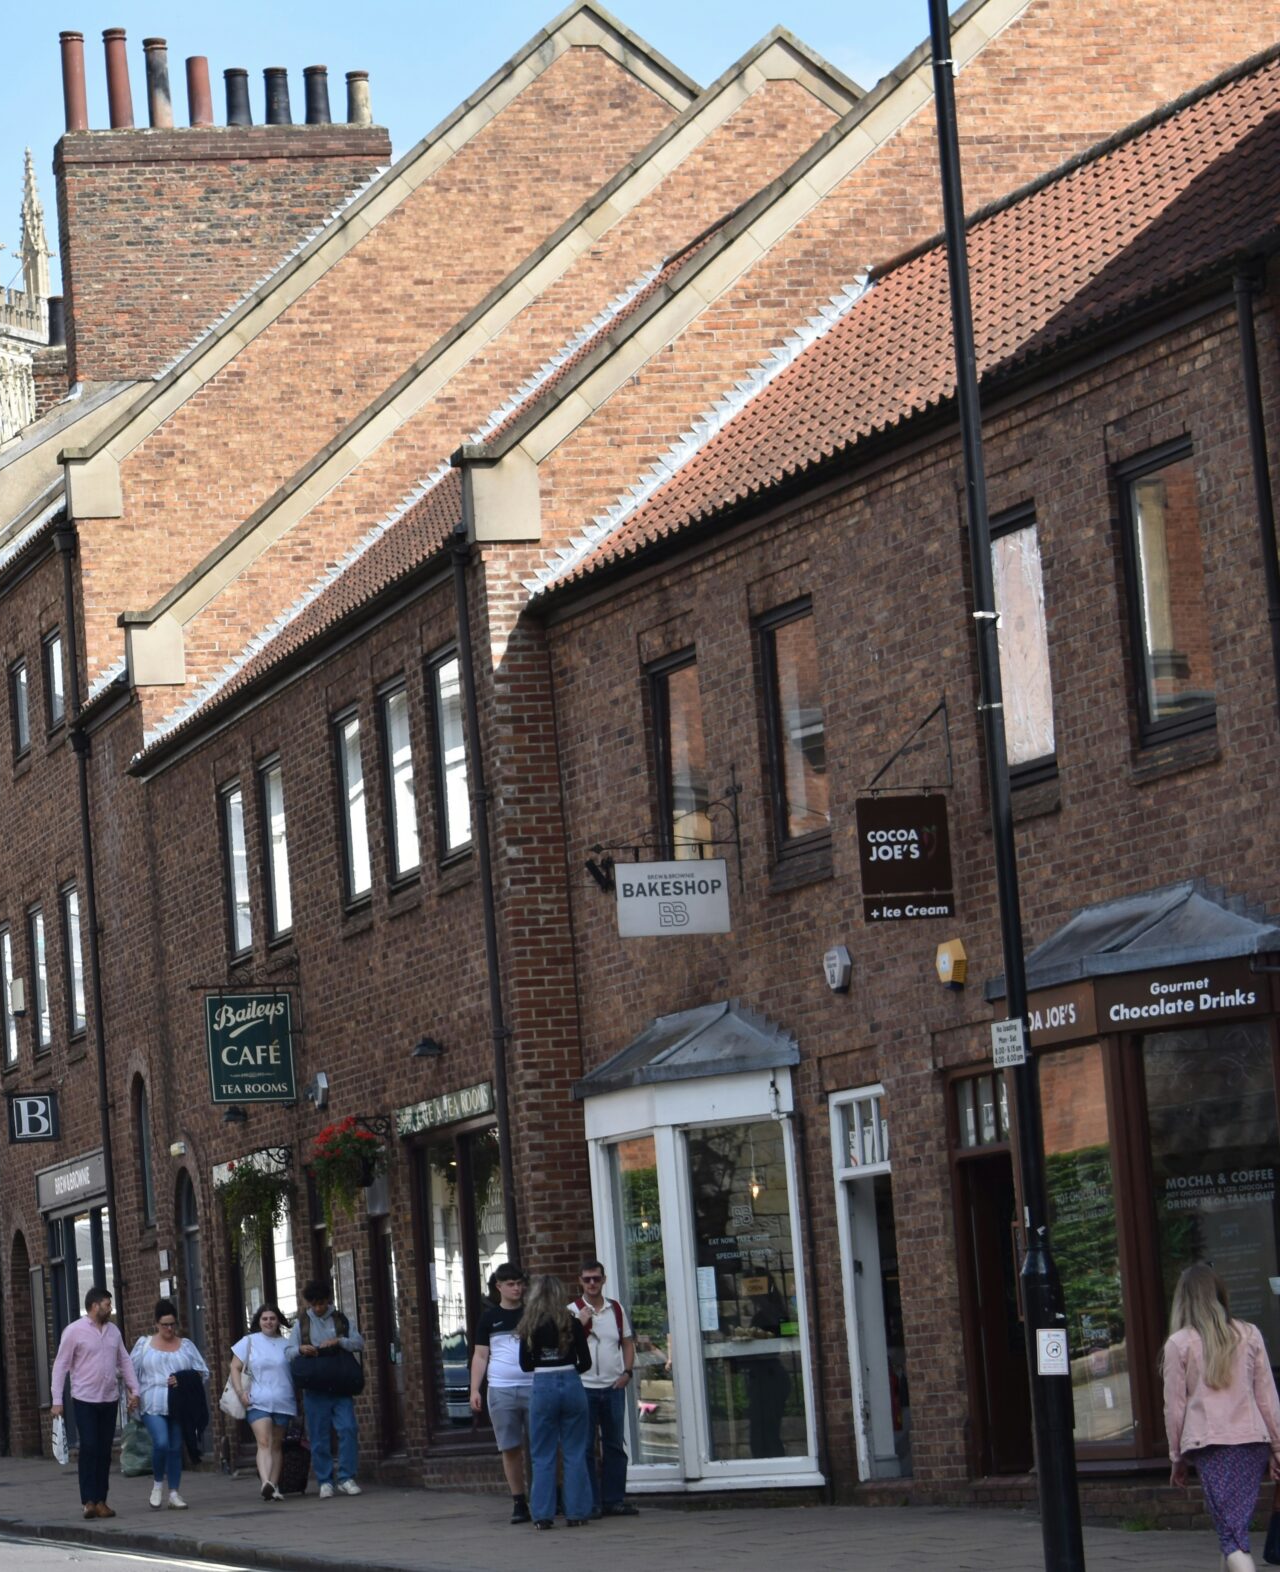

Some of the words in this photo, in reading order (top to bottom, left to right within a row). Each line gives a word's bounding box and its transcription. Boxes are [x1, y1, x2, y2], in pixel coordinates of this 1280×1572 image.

[867, 829, 918, 843] COCOA
[869, 844, 920, 861] JOE'S
[622, 880, 722, 897] BAKESHOP
[882, 906, 901, 918] Ice
[905, 904, 949, 917] Cream
[1150, 977, 1209, 995] Gourmet
[1109, 998, 1195, 1021] Chocolate
[1199, 988, 1256, 1010] Drinks
[213, 1000, 285, 1031] Baileys
[1045, 1002, 1077, 1028] JOE'S
[221, 1040, 281, 1066] CAFÉ
[221, 1084, 242, 1094] TEA
[245, 1083, 288, 1093] ROOMS
[460, 1084, 489, 1113] ROOMS
[16, 1100, 50, 1136] B
[1166, 1175, 1214, 1190] MOCHA
[1217, 1173, 1226, 1184] &
[1231, 1168, 1274, 1183] COFFEE
[1167, 1198, 1199, 1210] DRINK
[1226, 1193, 1252, 1203] TAKE
[1254, 1191, 1275, 1201] OUT
